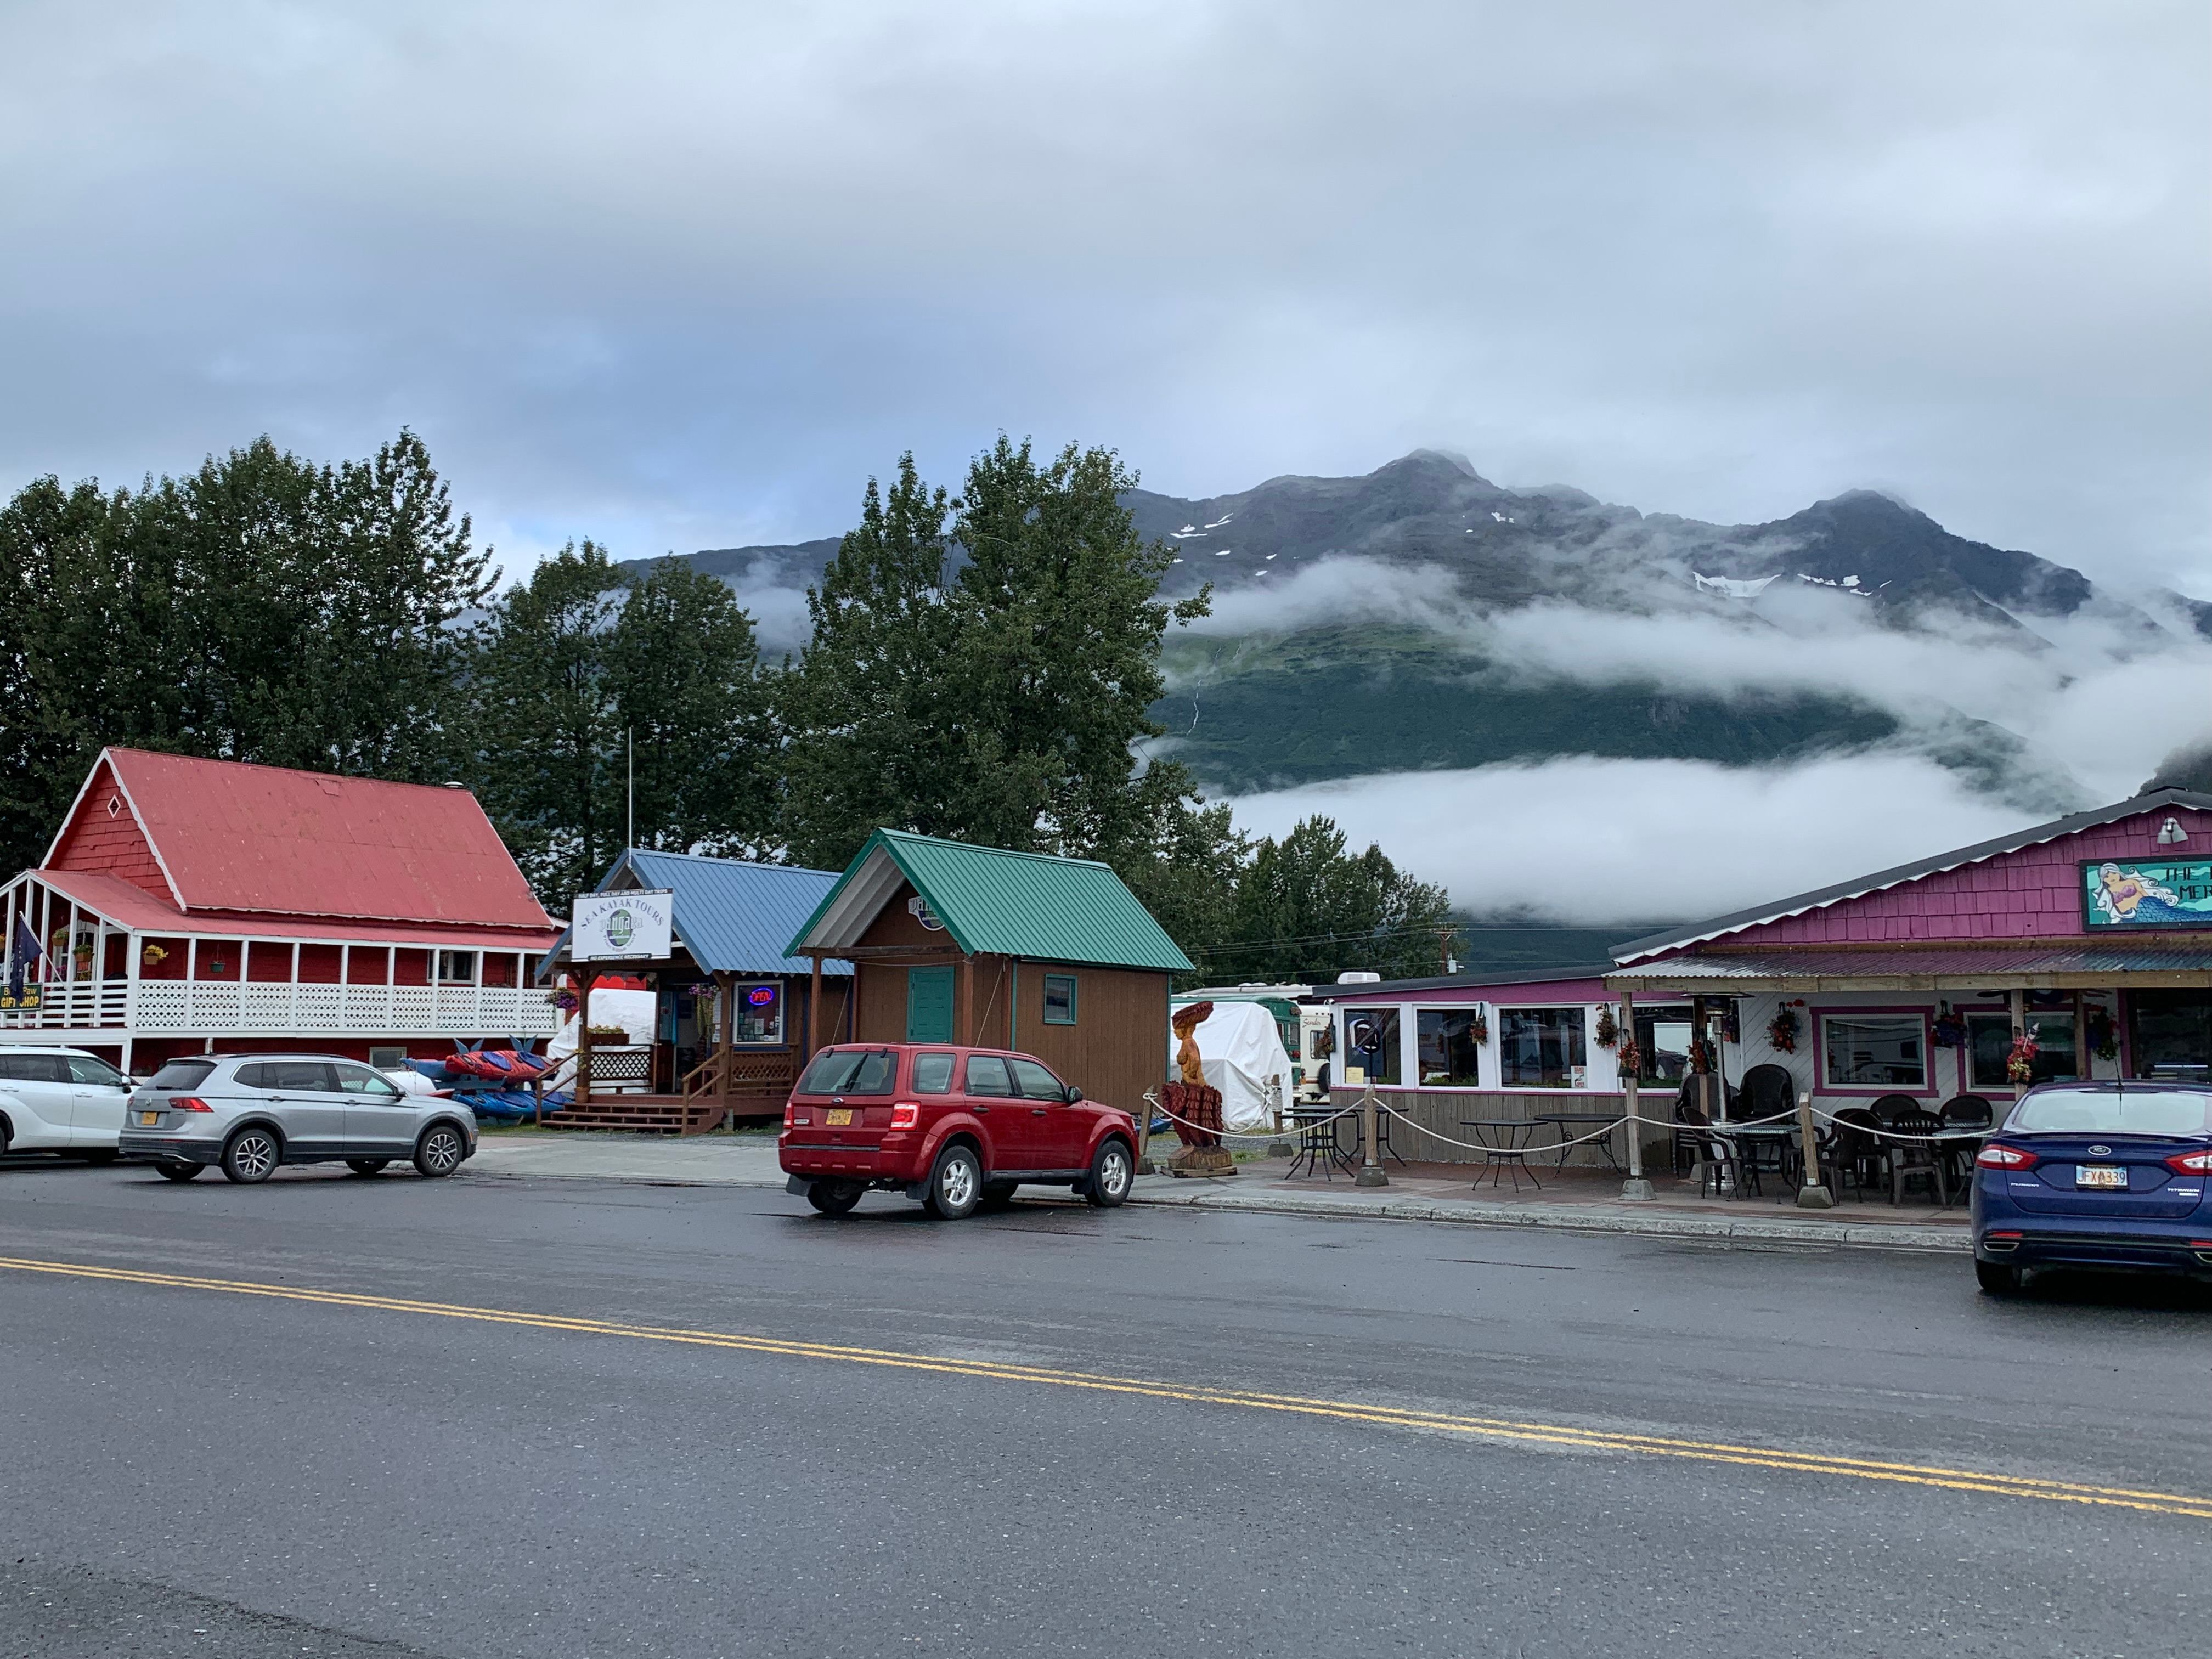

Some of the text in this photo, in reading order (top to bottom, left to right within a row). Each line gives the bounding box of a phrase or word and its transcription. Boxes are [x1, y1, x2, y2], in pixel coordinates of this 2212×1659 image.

[2161, 866, 2199, 882] THE
[581, 898, 664, 930] SEA KAYAK TOURS
[1, 996, 16, 1008] GIFT
[2106, 1172, 2126, 1184] 339
